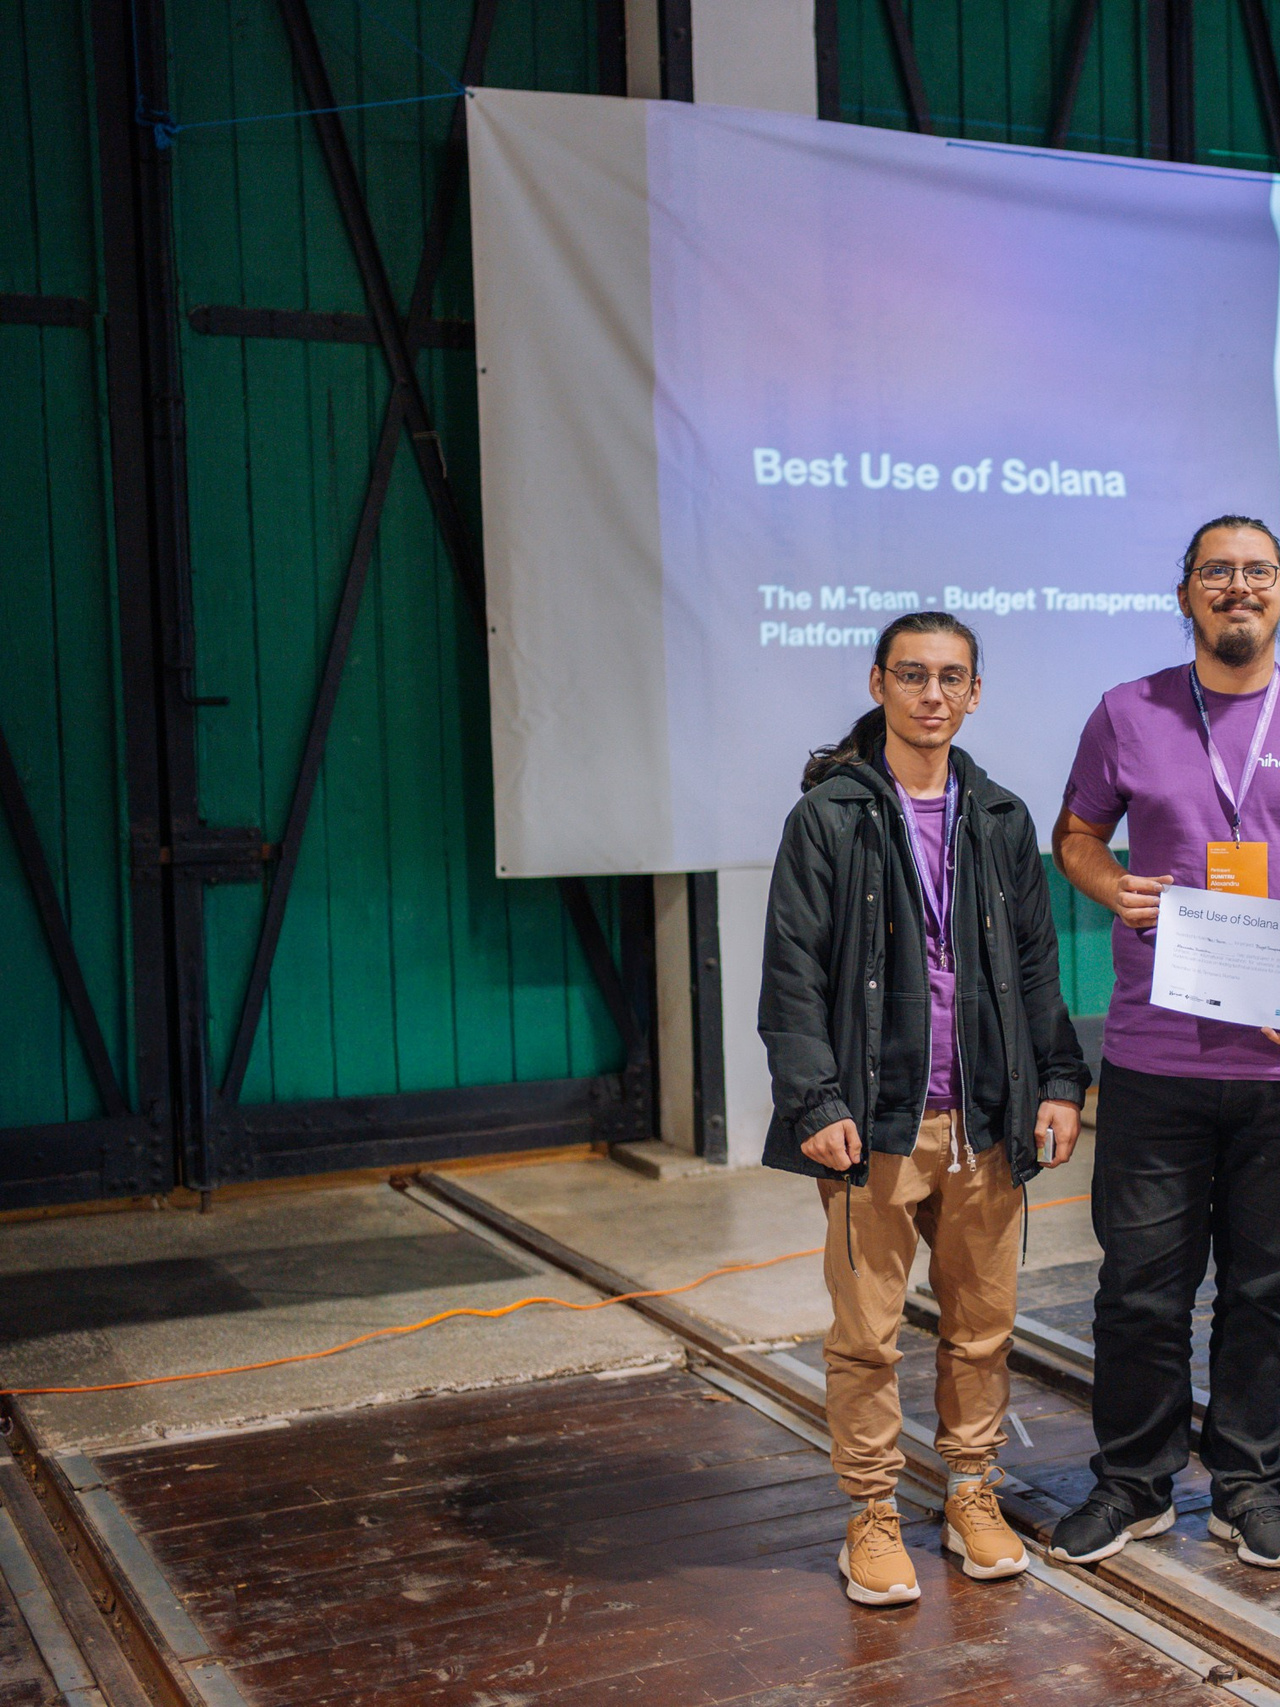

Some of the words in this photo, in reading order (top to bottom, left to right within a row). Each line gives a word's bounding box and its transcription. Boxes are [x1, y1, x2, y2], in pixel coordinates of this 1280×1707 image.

[753, 448, 848, 487] Best
[860, 453, 940, 492] Use
[951, 458, 992, 493] of
[1000, 458, 1126, 498] Solana
[758, 585, 811, 611] The
[820, 586, 919, 611] M-Team
[944, 586, 1035, 615] Budget
[1041, 588, 1181, 616] Transprenc
[760, 620, 878, 647] Platform
[1178, 905, 1204, 920] Best
[1206, 910, 1228, 923] Use
[1230, 914, 1242, 925] of
[1243, 915, 1279, 930] Solana
